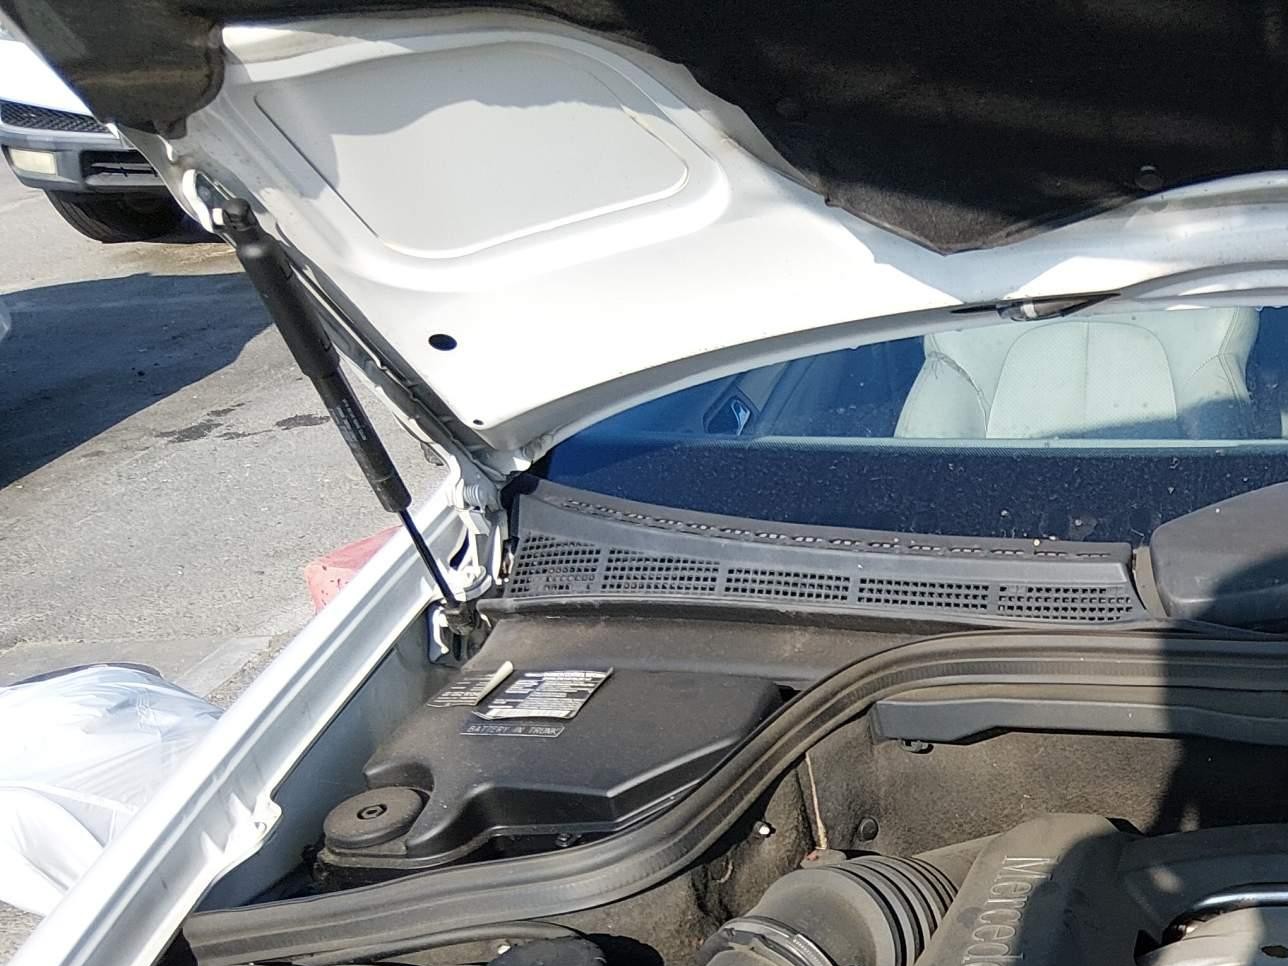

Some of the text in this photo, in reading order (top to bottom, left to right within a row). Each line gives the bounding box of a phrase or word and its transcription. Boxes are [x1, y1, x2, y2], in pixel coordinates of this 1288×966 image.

[467, 725, 561, 735] BATTERY IN TRUNK
